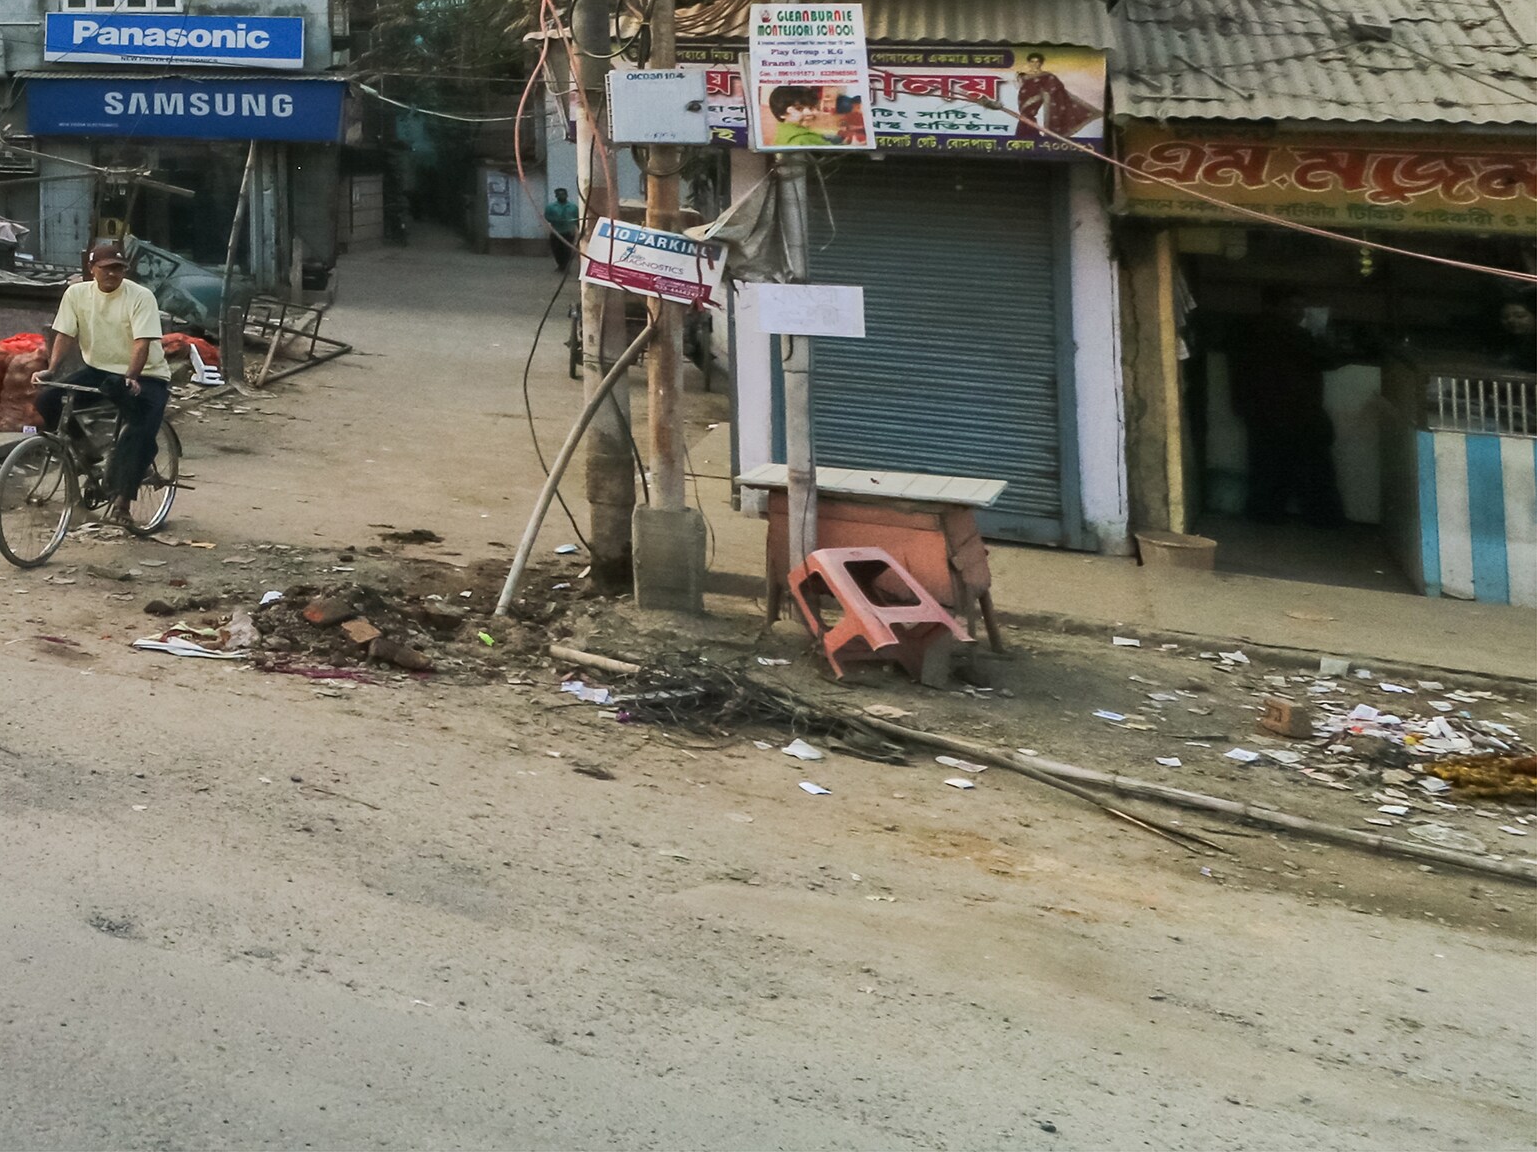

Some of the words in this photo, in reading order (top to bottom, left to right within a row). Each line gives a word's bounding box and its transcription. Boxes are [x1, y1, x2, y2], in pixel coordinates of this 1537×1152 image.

[777, 10, 853, 22] GLEANBURNIE
[73, 20, 271, 49] Panasonic
[758, 24, 814, 36] MONTESSORI
[817, 24, 854, 36] SCHOOL
[104, 92, 294, 117] SAMSUNG
